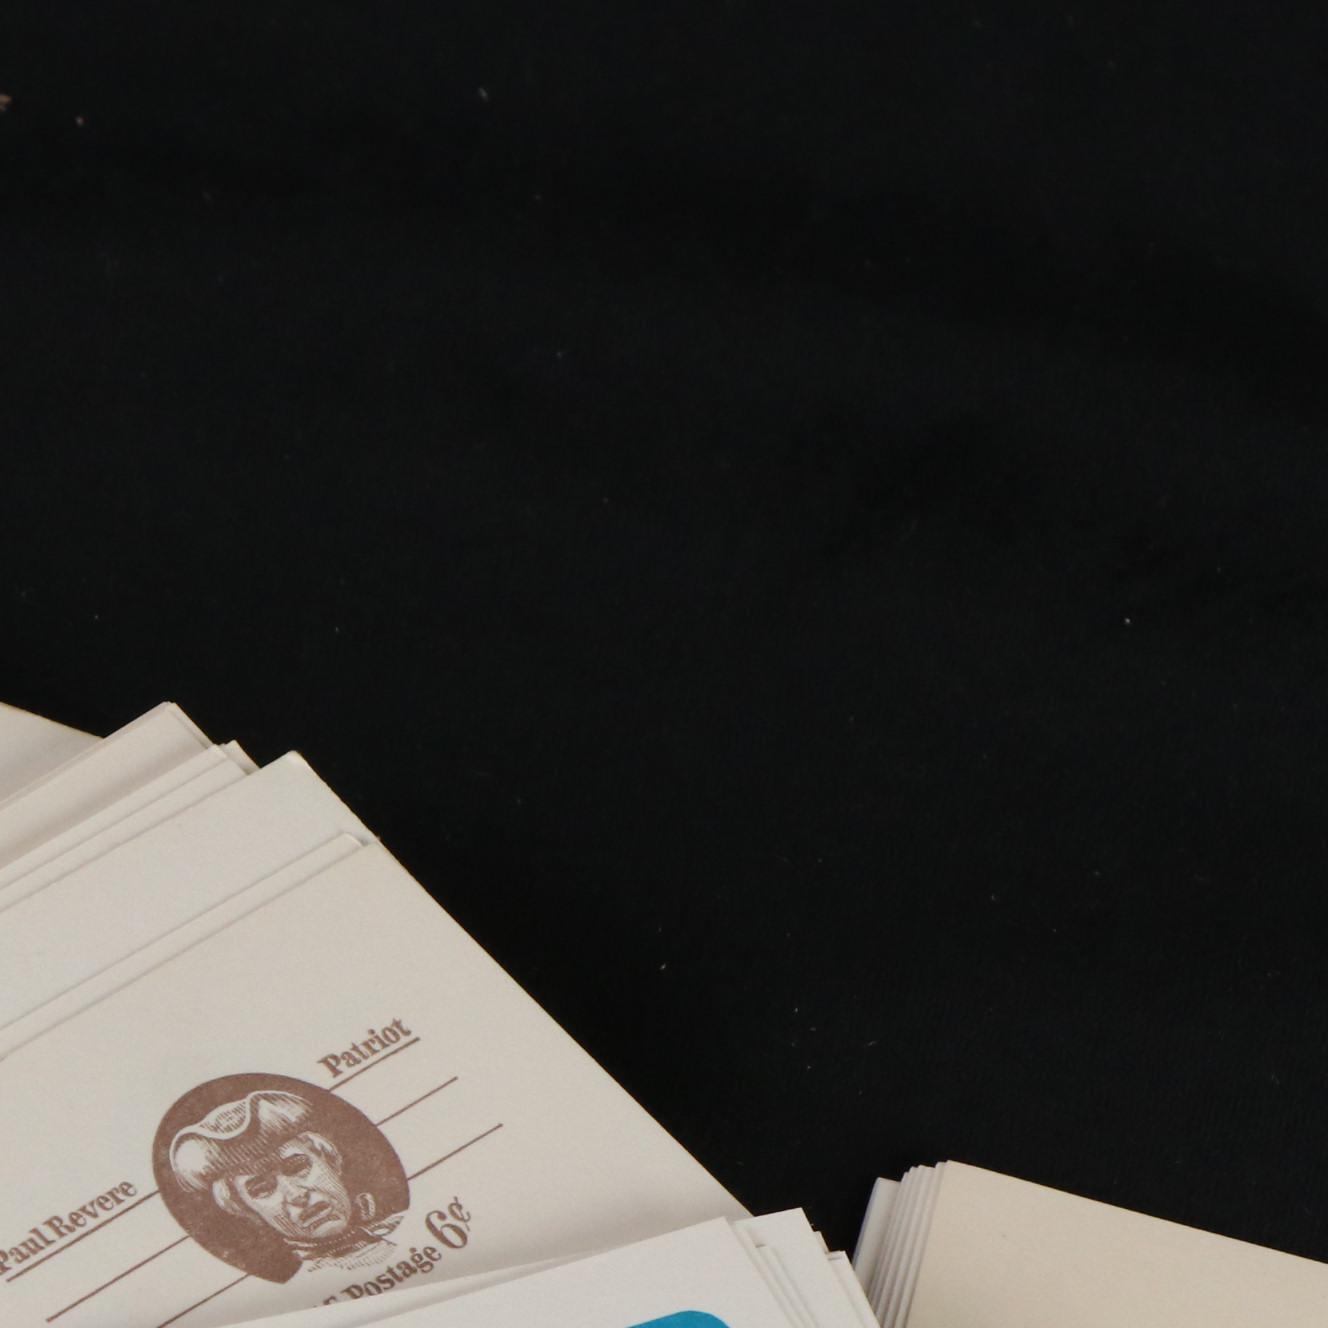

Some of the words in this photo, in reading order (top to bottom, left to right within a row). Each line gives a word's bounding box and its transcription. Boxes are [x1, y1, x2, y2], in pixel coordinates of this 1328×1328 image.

[316, 1017, 412, 1078] Patriot
[42, 1181, 137, 1238] Revere
[340, 1246, 442, 1299] Postage
